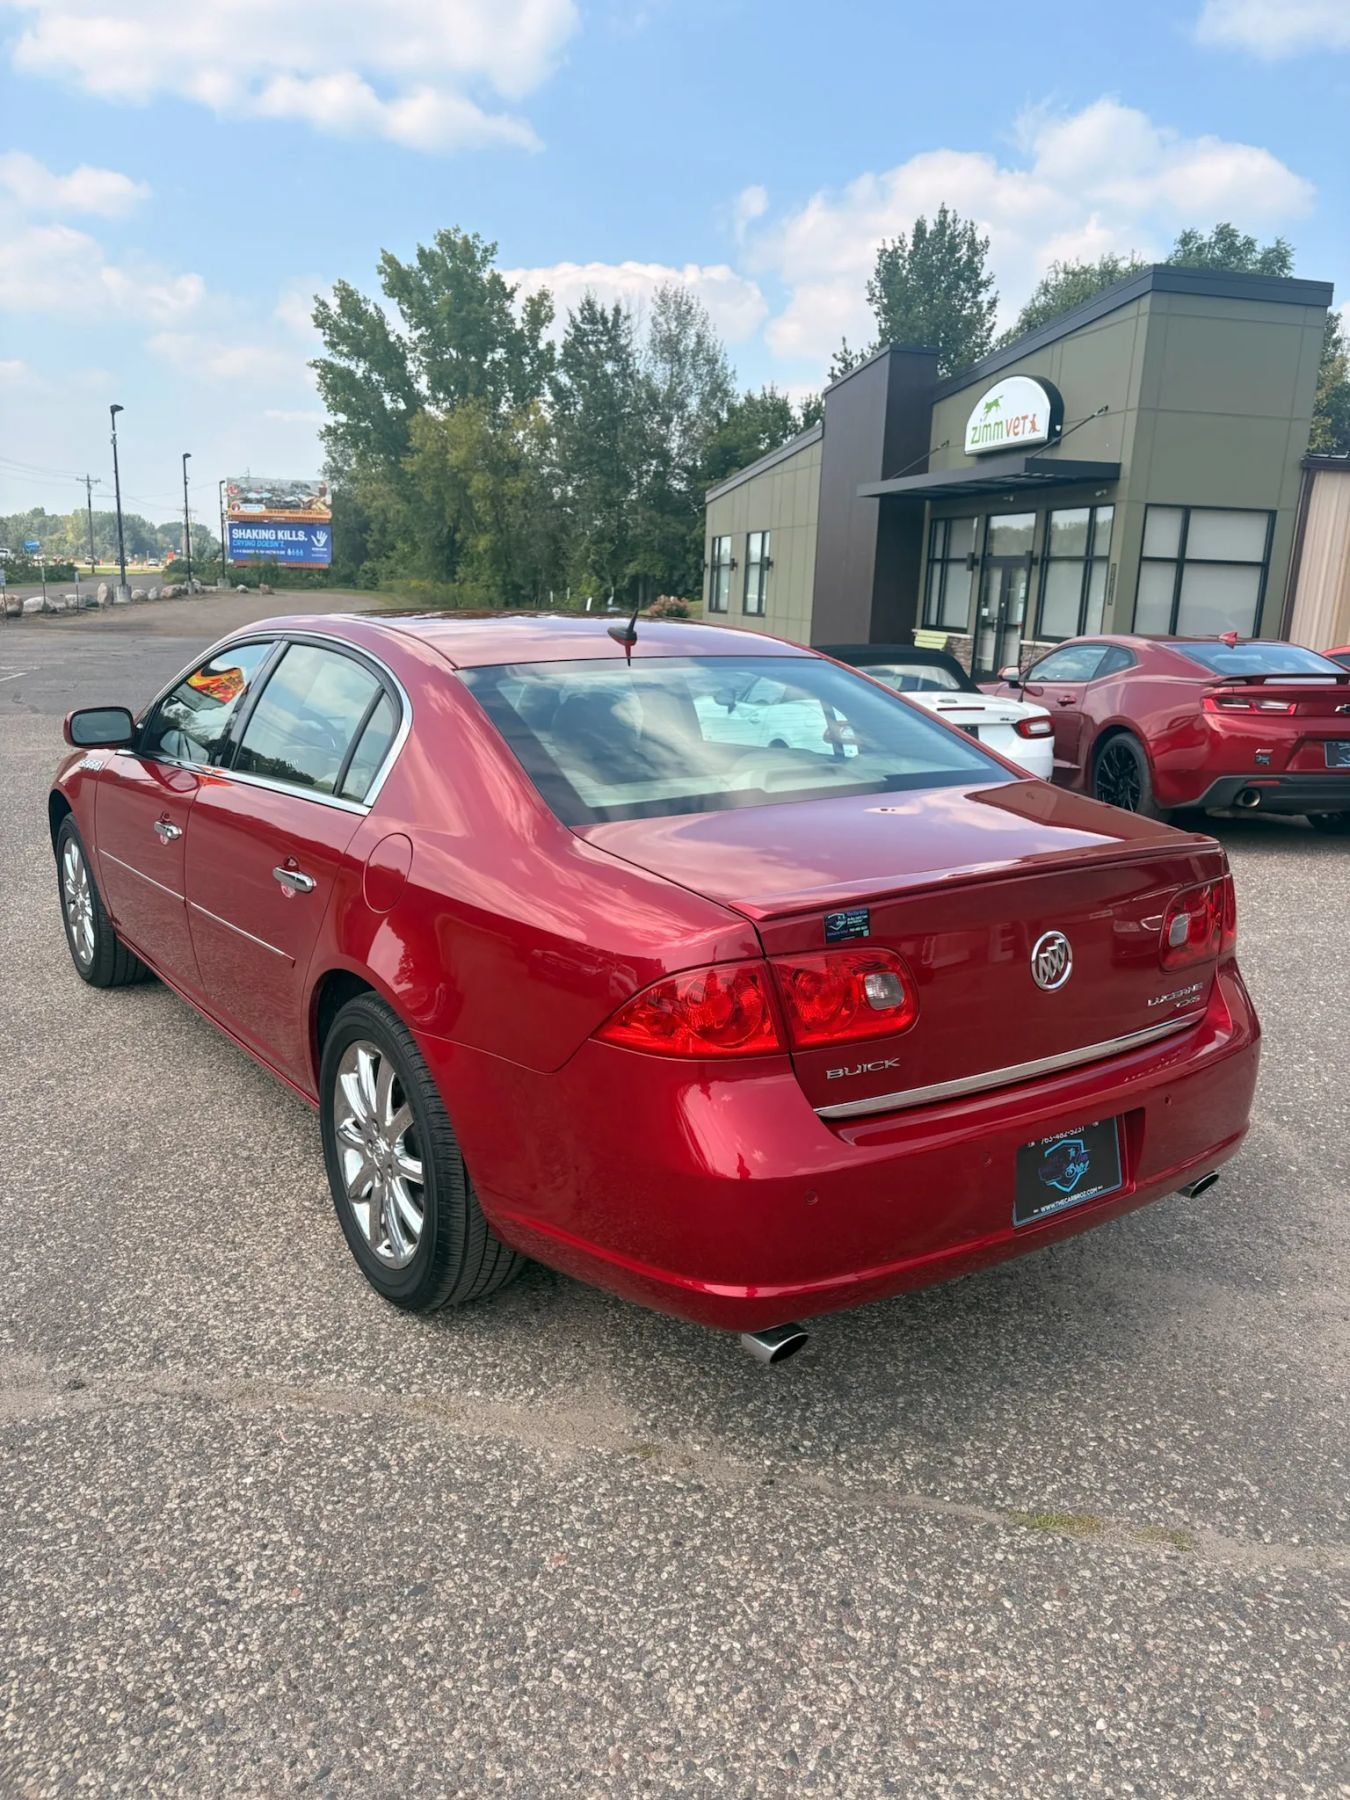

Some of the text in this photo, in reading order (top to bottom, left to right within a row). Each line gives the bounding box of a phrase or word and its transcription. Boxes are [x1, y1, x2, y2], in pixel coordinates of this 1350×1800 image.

[232, 528, 308, 541] SHAKING KILLS.
[1147, 982, 1203, 1007] LUCERNE
[1176, 994, 1201, 1008] CXS
[825, 1057, 901, 1080] BUICK
